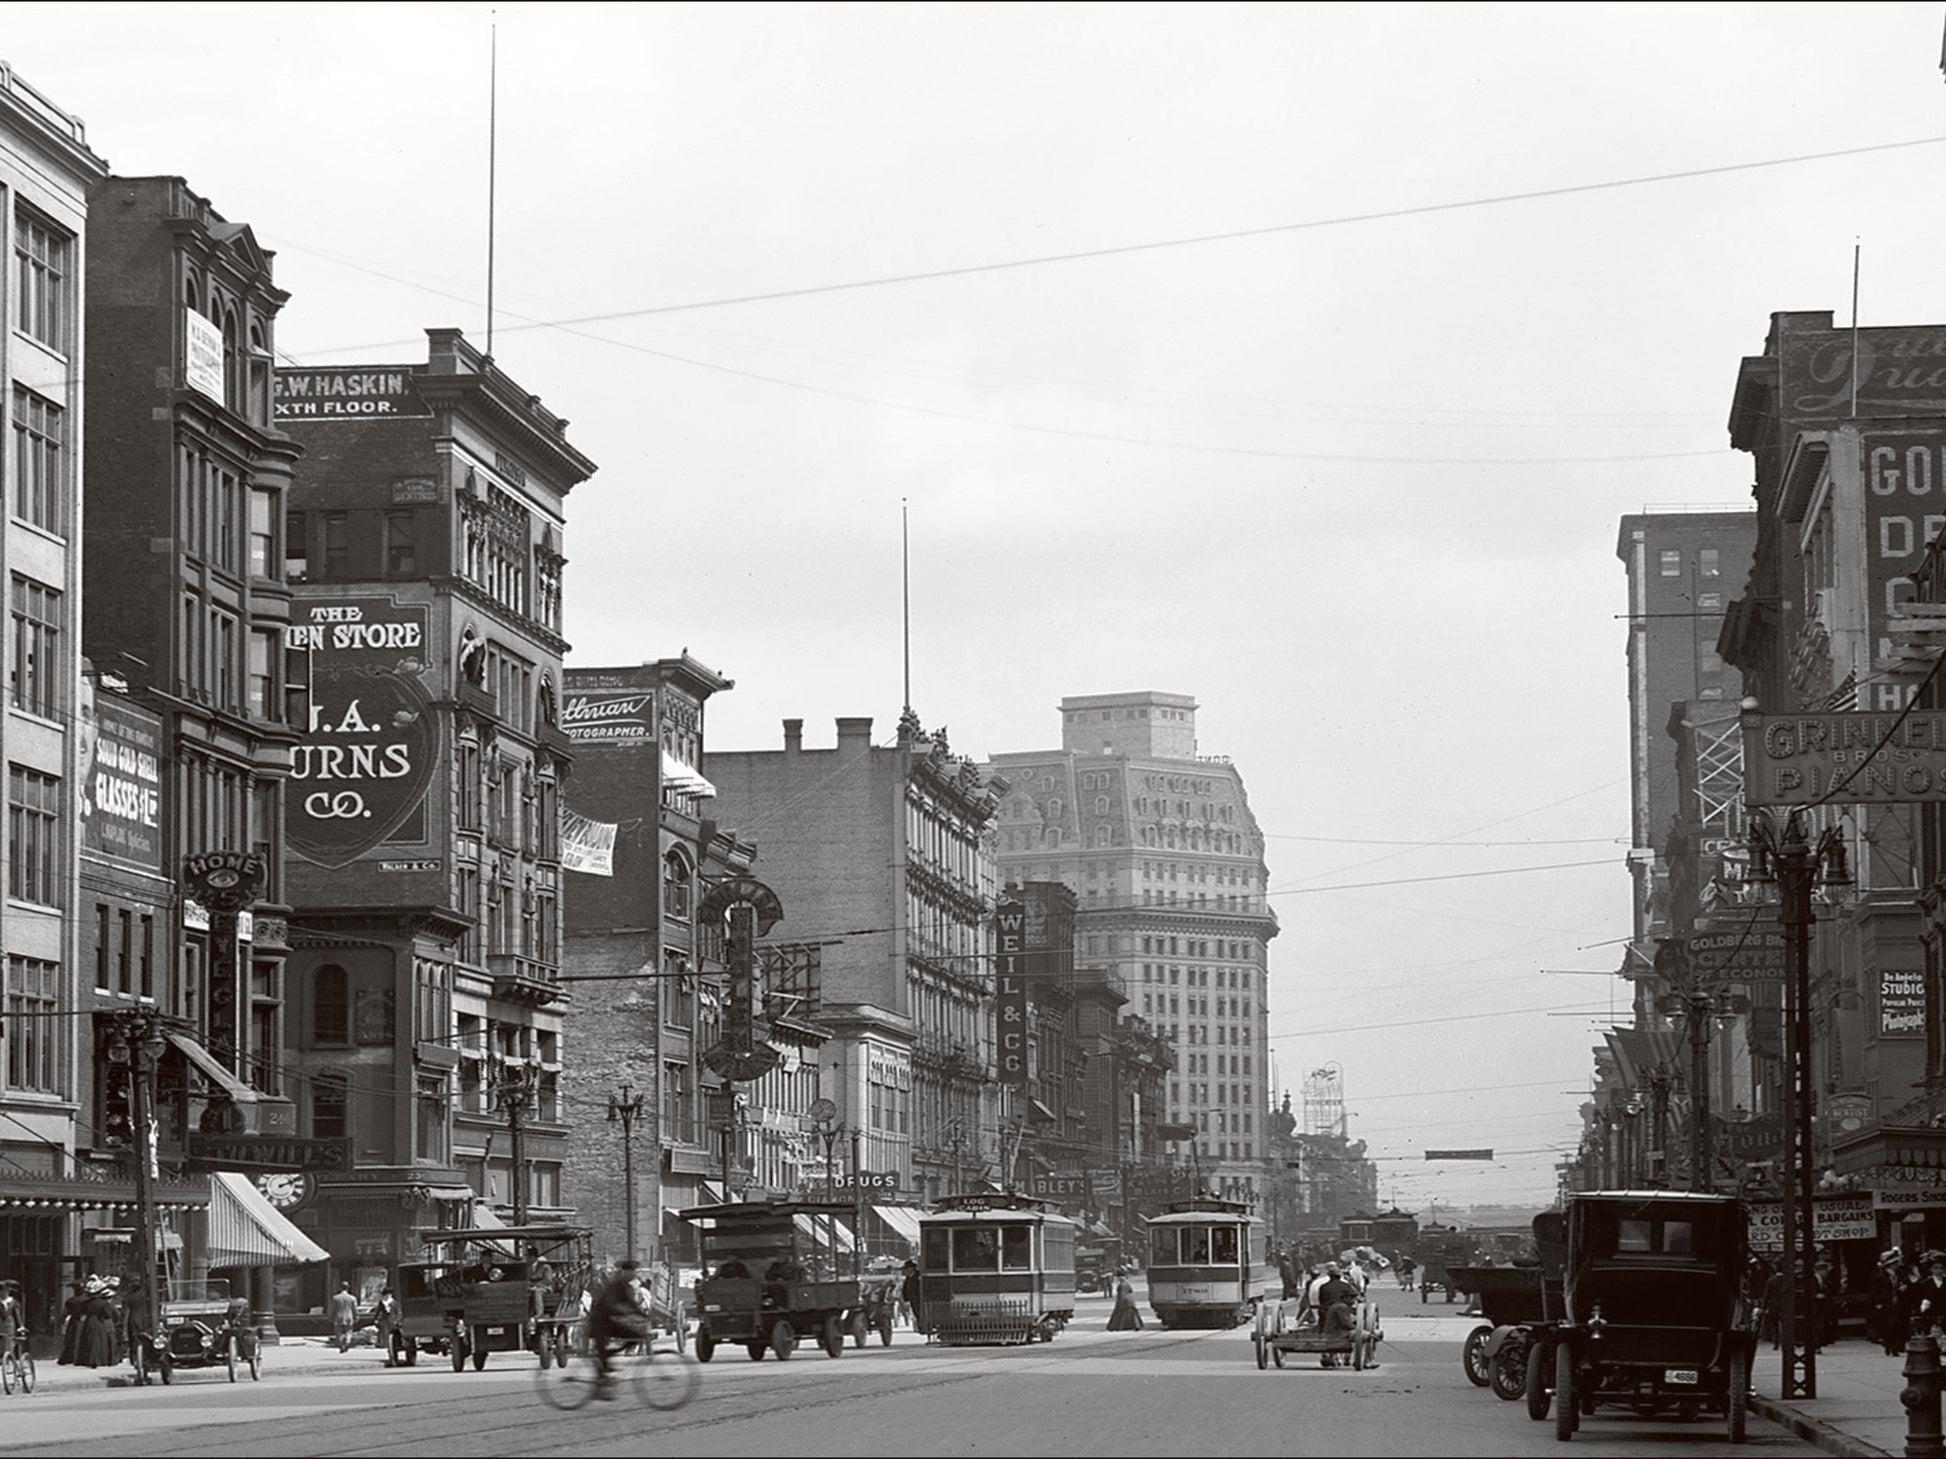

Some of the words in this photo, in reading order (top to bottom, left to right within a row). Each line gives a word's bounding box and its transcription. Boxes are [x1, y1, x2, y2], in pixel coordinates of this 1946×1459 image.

[323, 400, 399, 415] FLOOR.
[310, 607, 363, 622] THE
[333, 622, 422, 649] STORE
[119, 744, 137, 776] GOLD
[137, 751, 159, 784] SHELL
[95, 772, 139, 822] GLASSES
[304, 790, 373, 819] CO.
[189, 855, 259, 876] HOME
[998, 914, 1023, 994] WEIL
[1003, 1005, 1021, 1022] &
[834, 1174, 896, 1189] DRUGS
[1014, 1180, 1086, 1194] MBLEY'S
[1880, 1191, 1919, 1204] ROGERS
[1817, 1211, 1874, 1224] BARGAINS
[1833, 1226, 1870, 1239] SHOP.
